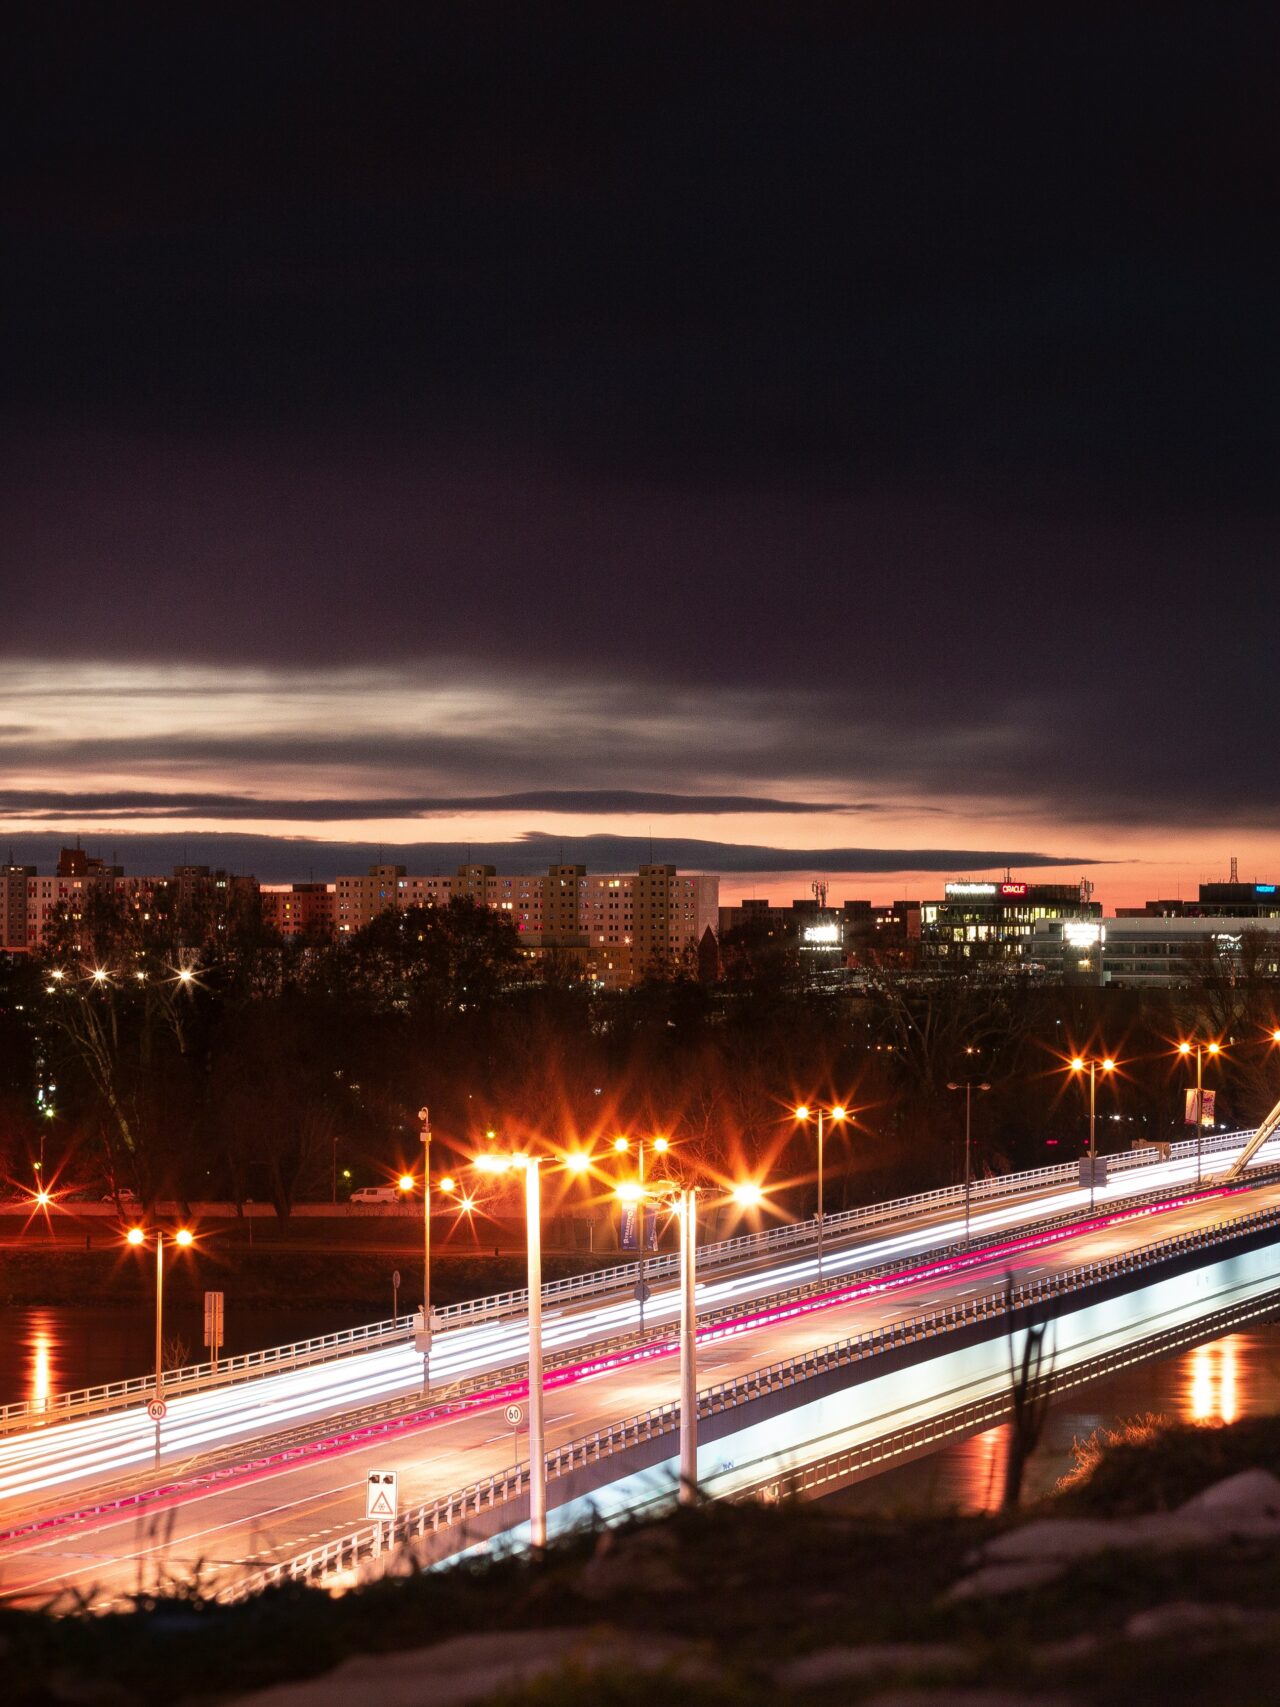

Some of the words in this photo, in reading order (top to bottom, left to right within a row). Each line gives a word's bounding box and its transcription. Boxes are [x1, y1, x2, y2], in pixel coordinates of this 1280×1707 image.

[1002, 885, 1025, 893] ORACLE
[151, 1404, 163, 1416] 60
[508, 1408, 519, 1420] 60
